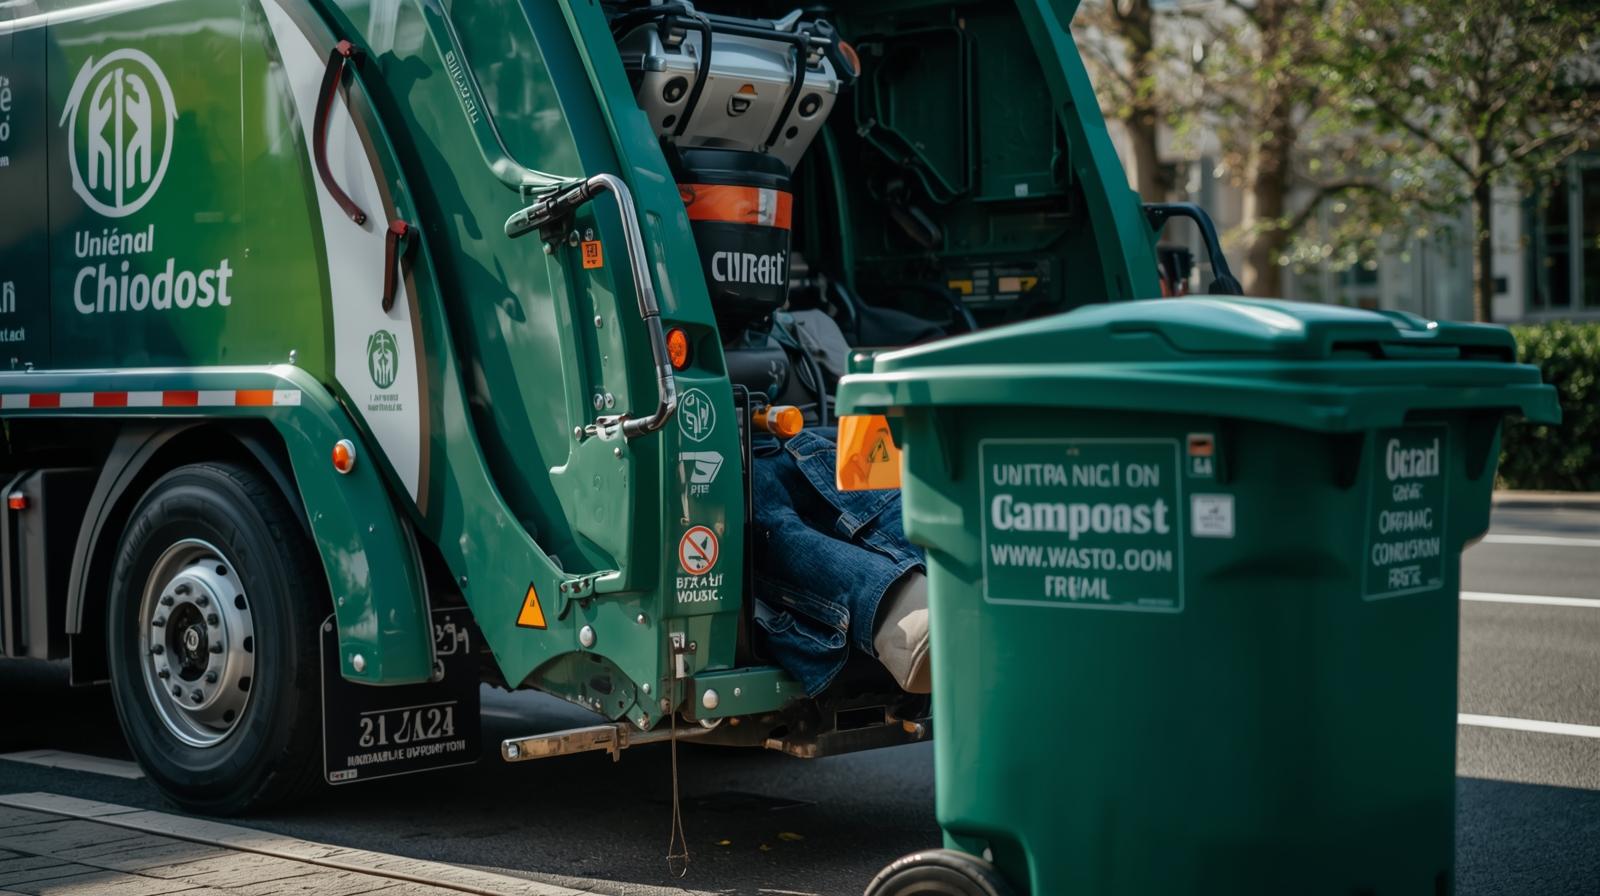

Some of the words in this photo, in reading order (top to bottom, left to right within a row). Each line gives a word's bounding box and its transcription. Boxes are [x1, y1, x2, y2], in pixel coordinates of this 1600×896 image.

[75, 224, 154, 258] Uniénal
[74, 257, 233, 315] Chiodost
[1126, 463, 1160, 487] ON
